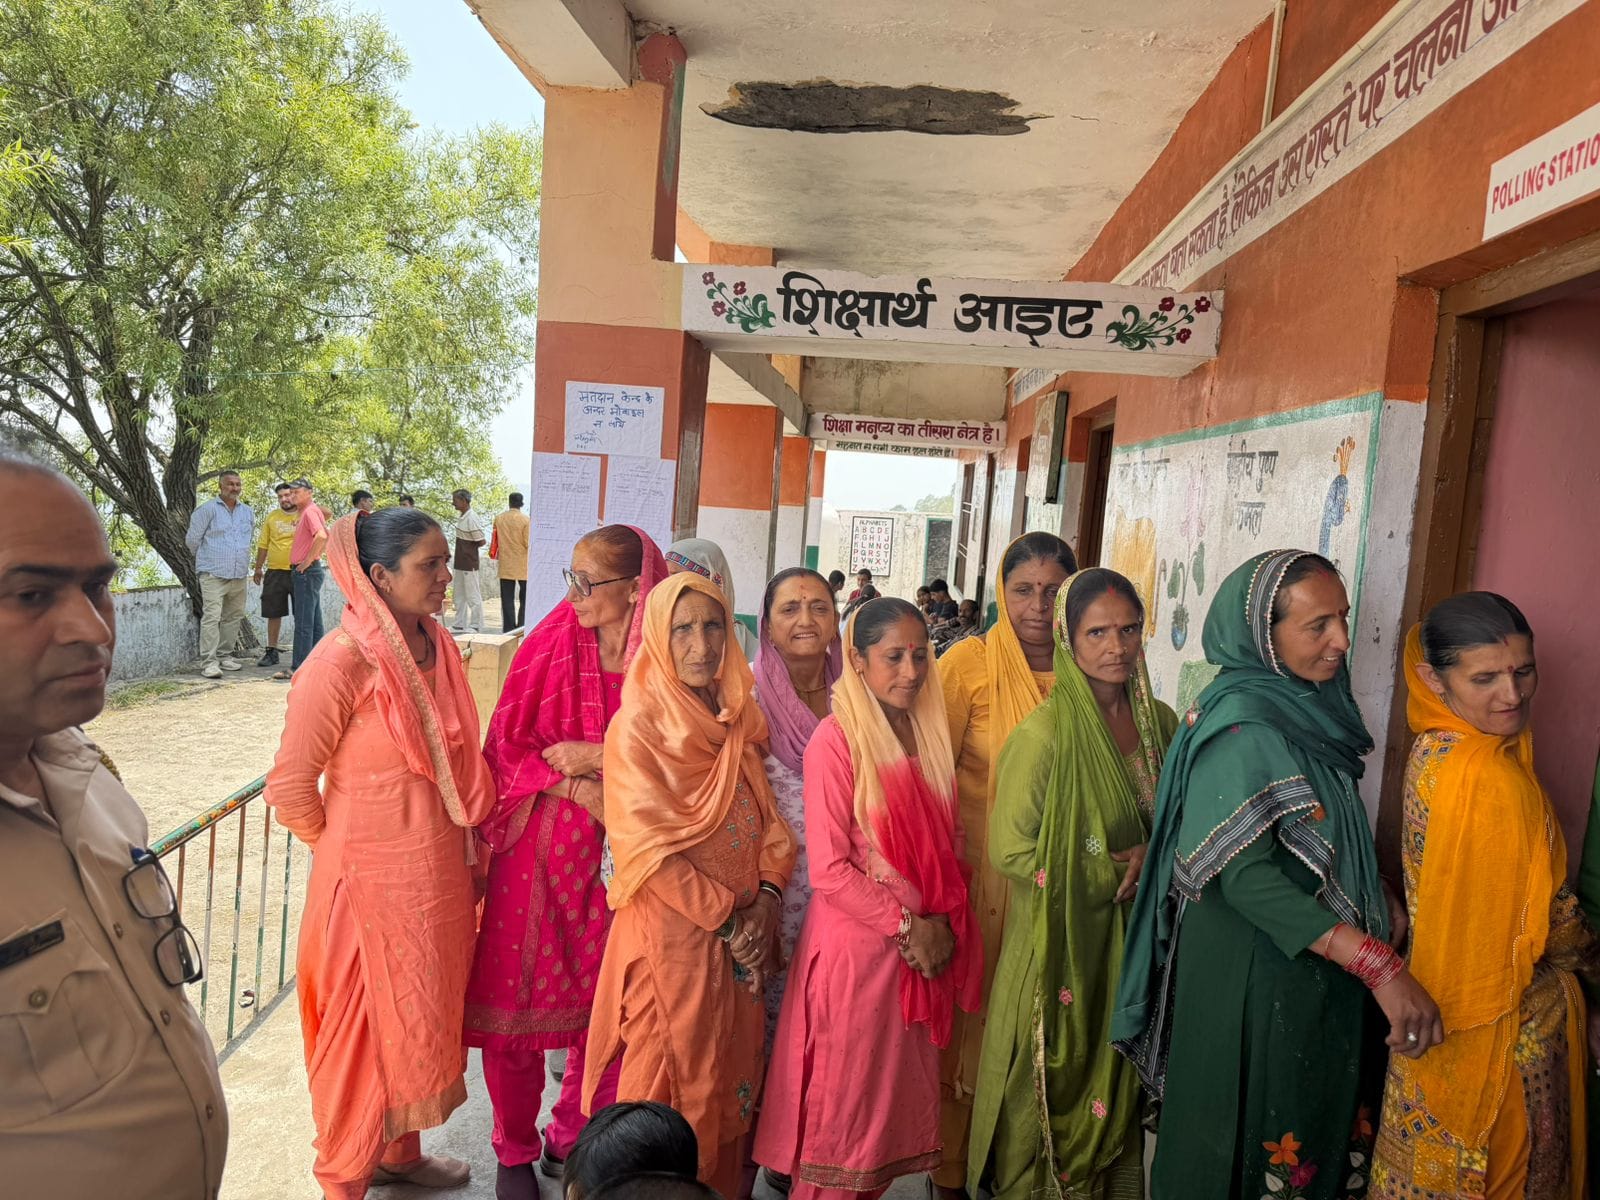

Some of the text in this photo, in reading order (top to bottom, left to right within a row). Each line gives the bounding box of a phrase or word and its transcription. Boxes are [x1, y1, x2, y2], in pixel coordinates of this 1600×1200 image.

[1170, 235, 1189, 277] बता
[1188, 207, 1219, 266] सकता
[1230, 158, 1280, 237] लेकिन
[1278, 132, 1307, 198] उस
[1305, 81, 1356, 185] रास्ते
[1359, 60, 1391, 128] पर
[1393, 0, 1474, 99] चलना
[1492, 133, 1600, 214] POLLING STATIO
[776, 271, 1103, 348] शिक्षार्थ आइए
[578, 390, 615, 404] मतदान
[582, 404, 645, 418] अन्दर मोबाइल
[593, 420, 604, 428] न
[822, 414, 853, 436] शिक्षा
[897, 422, 915, 437] का
[918, 420, 955, 440] तीसरा
[957, 421, 981, 441] नेत्र
